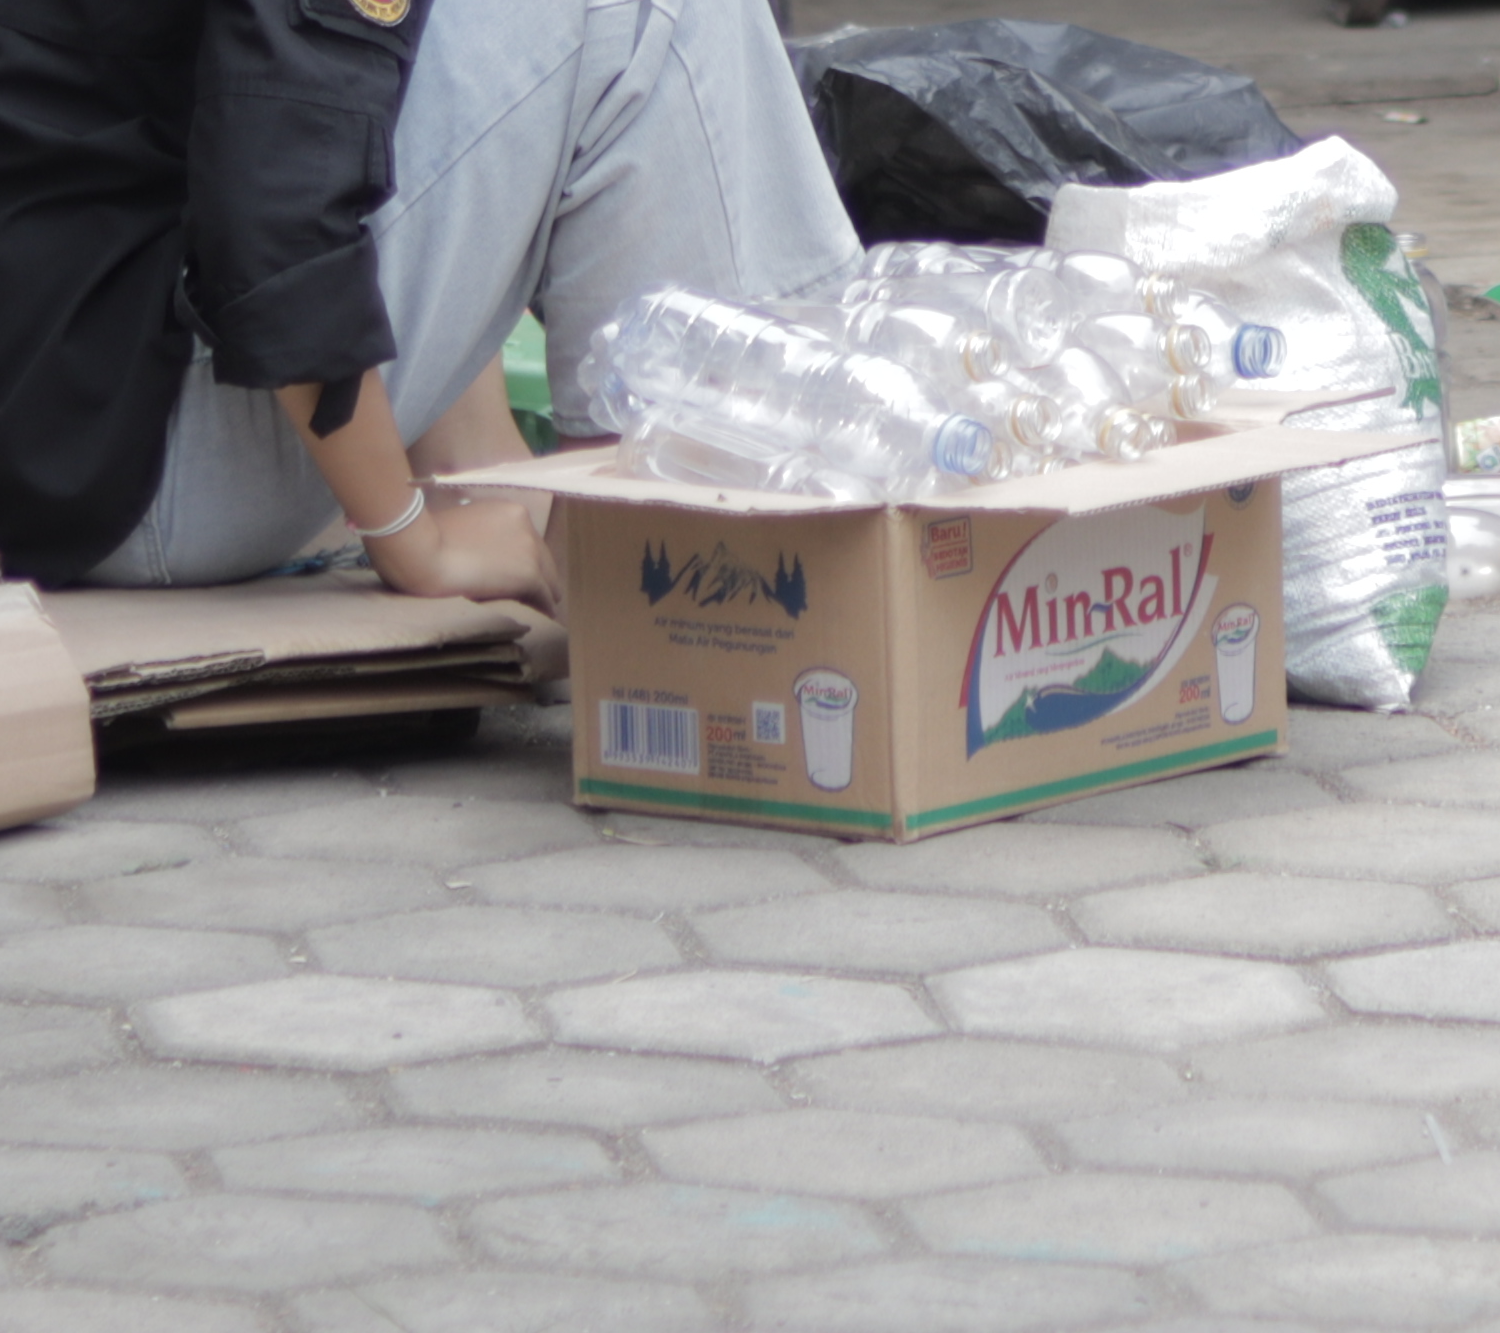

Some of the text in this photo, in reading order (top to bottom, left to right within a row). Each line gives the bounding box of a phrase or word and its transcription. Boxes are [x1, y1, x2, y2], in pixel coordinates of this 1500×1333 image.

[930, 522, 968, 543] Baru!
[705, 620, 734, 636] yang
[668, 632, 695, 647] Mata
[711, 637, 778, 656] Pegunungan
